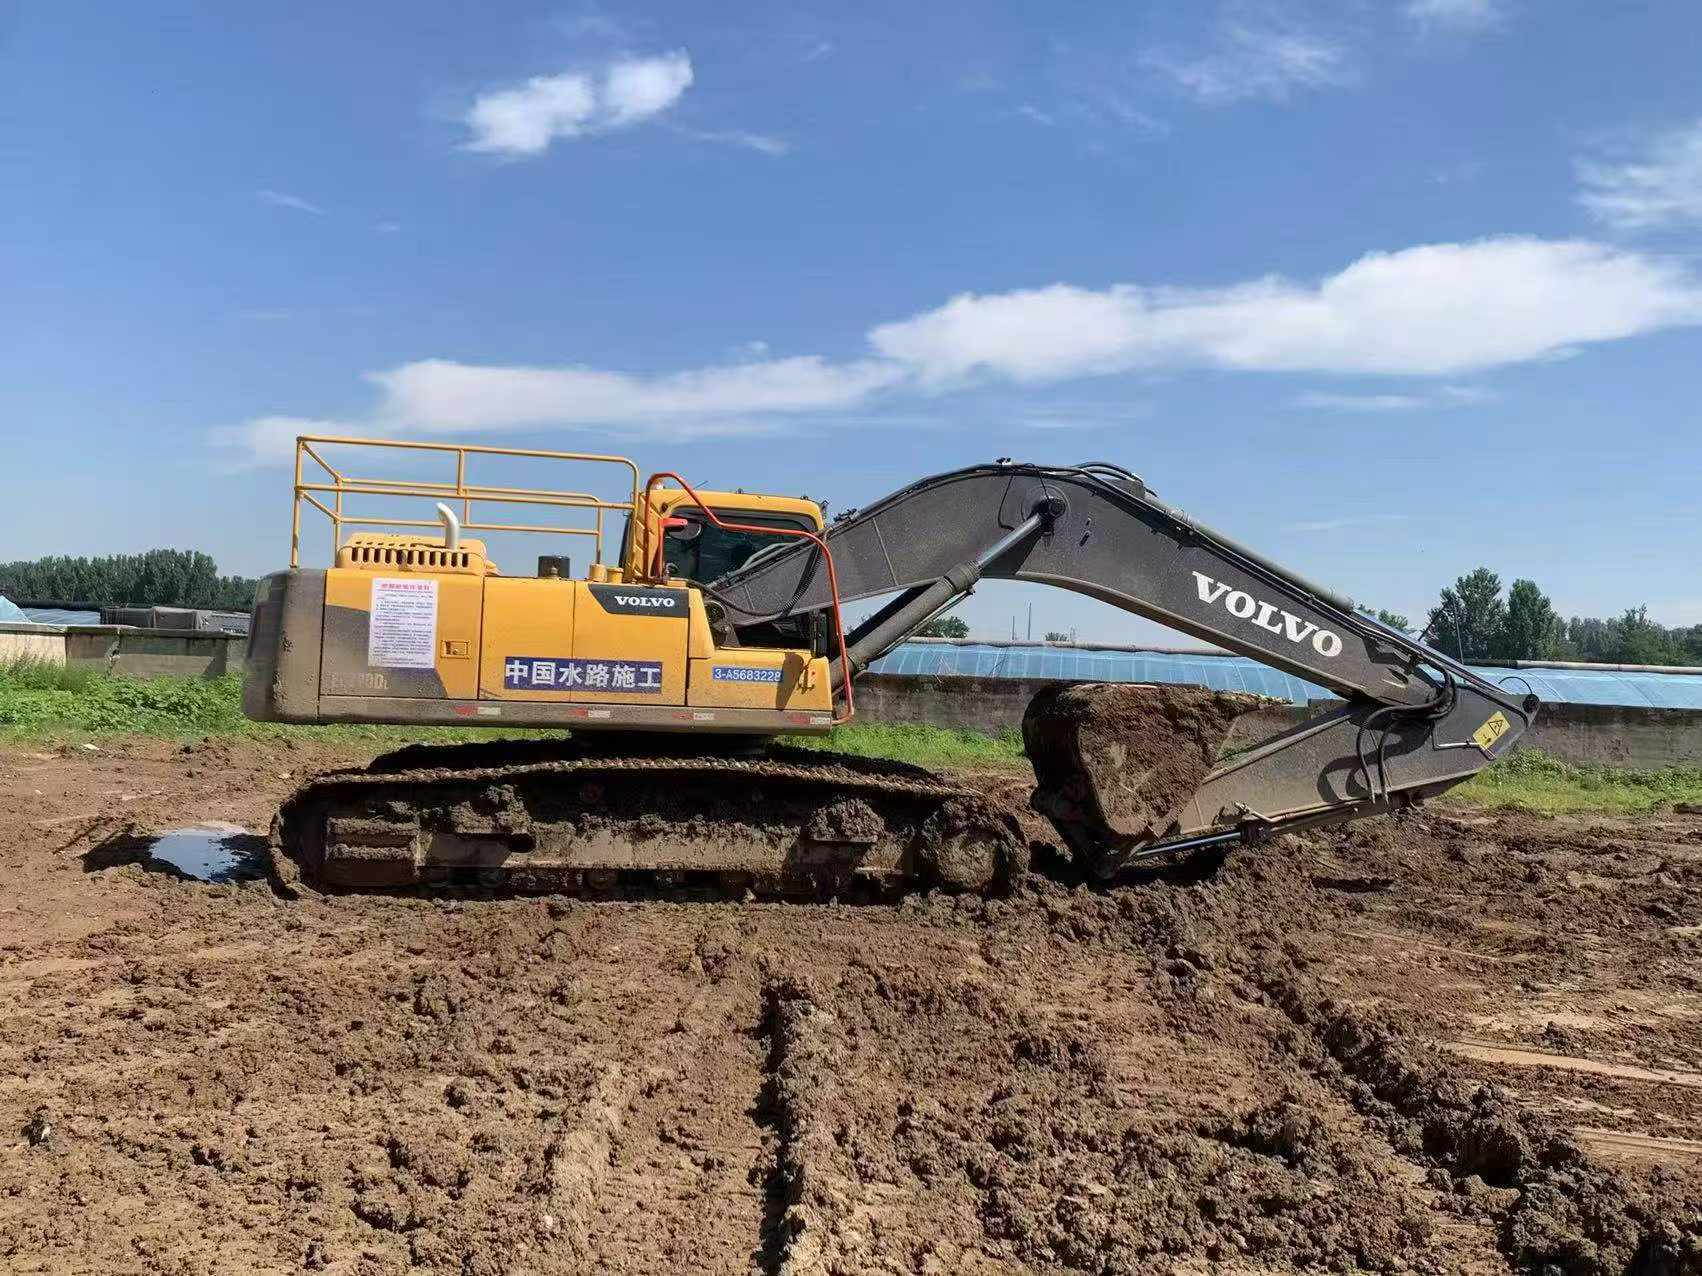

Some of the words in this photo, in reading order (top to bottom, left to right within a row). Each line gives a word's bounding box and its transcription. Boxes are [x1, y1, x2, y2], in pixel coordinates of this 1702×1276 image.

[614, 595, 675, 607] VOLVO
[1192, 570, 1343, 657] VOLVO
[505, 659, 661, 689] 中国水路施工
